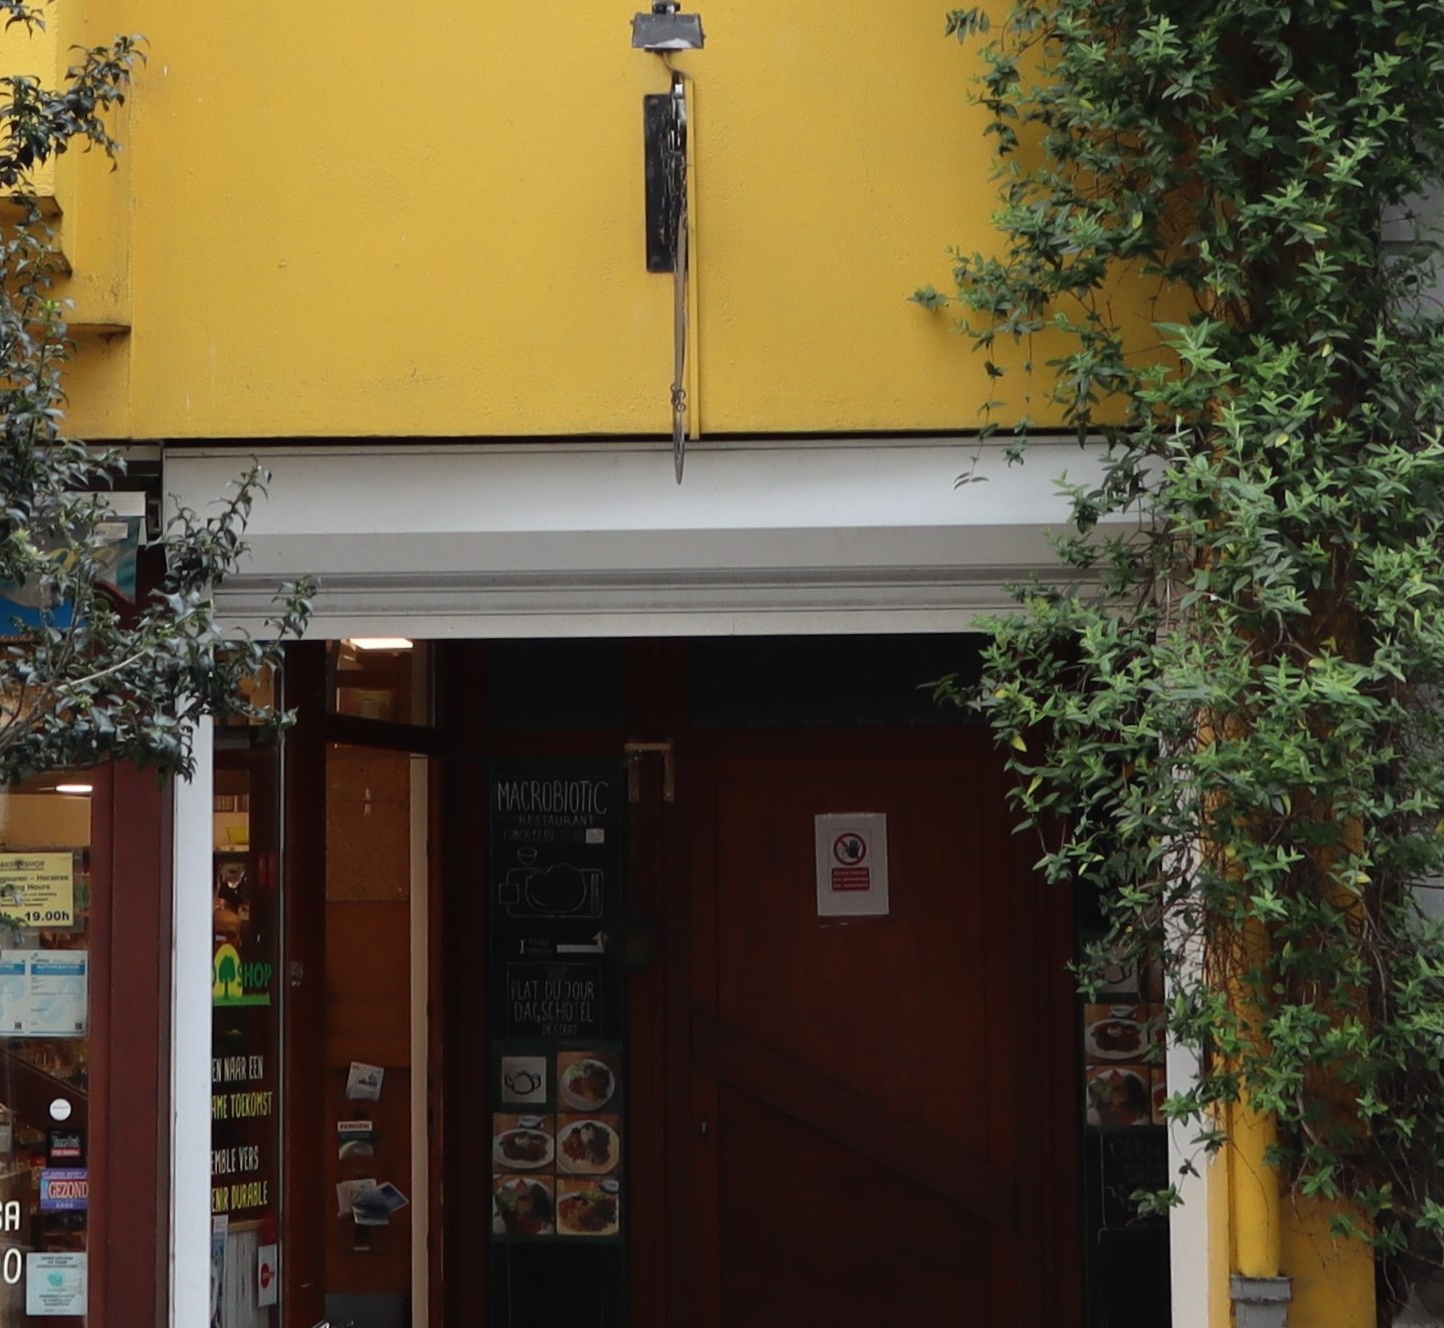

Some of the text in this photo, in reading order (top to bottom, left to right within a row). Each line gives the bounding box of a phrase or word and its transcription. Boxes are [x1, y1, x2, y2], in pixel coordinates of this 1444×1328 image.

[518, 813, 595, 827] RESTAURANT
[25, 911, 70, 922] 19.00h
[511, 980, 596, 1001] PLAT DU JOUR
[514, 1001, 594, 1024] DAGSCHOTEL
[224, 1056, 246, 1082] NAAR
[249, 1054, 264, 1079] EEN
[230, 1091, 273, 1118] TOEKOMST
[48, 1180, 89, 1200] GEZOND
[231, 1180, 268, 1210] DURABLE
